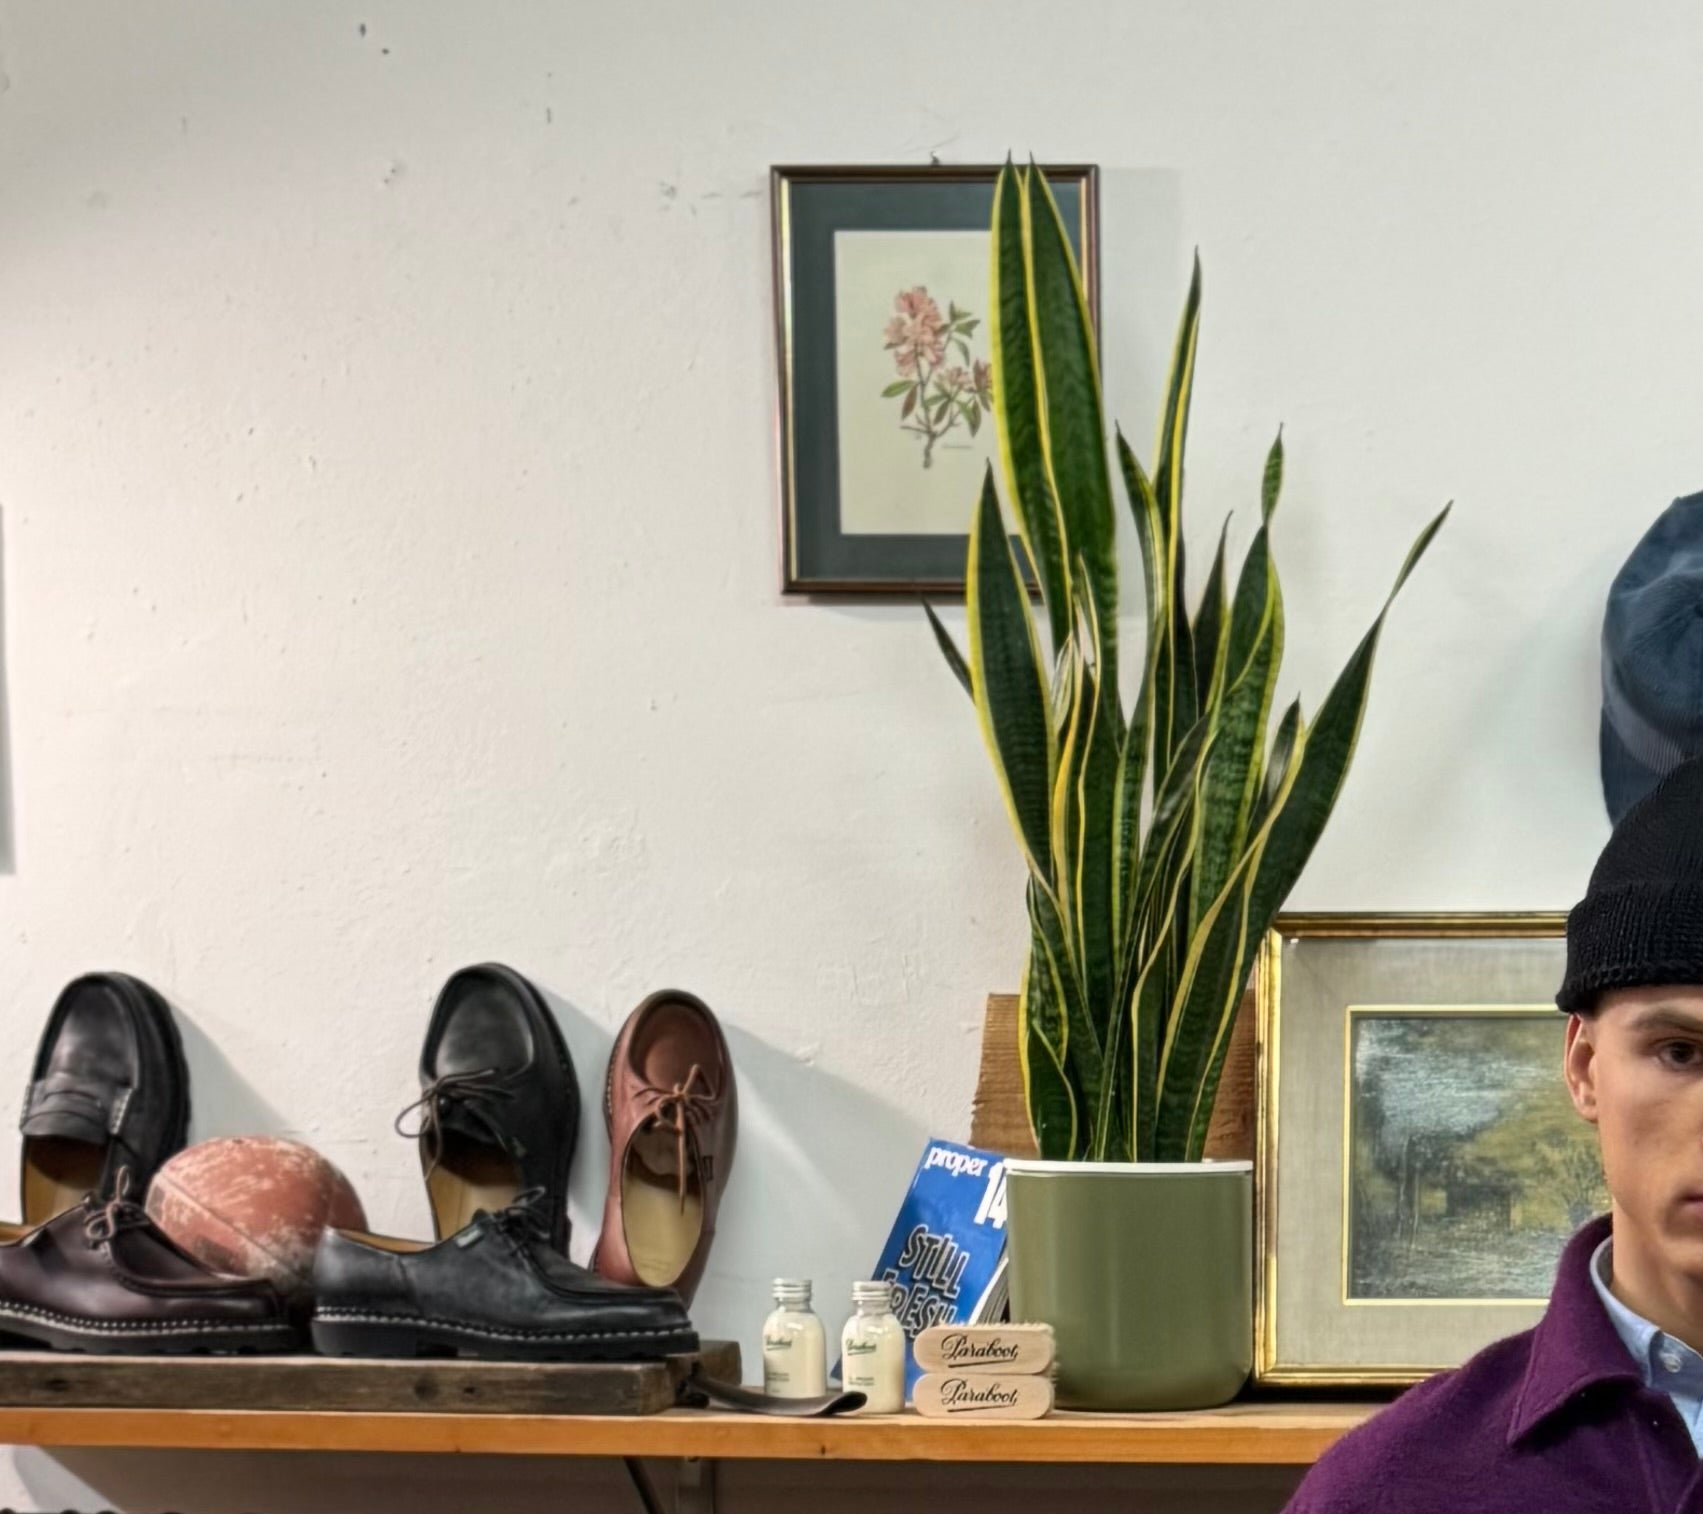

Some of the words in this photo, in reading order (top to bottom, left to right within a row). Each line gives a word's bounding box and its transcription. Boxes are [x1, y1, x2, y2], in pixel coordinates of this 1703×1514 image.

[923, 1147, 988, 1177] proper
[899, 1224, 970, 1299] STILL
[941, 1333, 1018, 1361] Paraboot
[940, 1378, 1018, 1406] Paraboot
